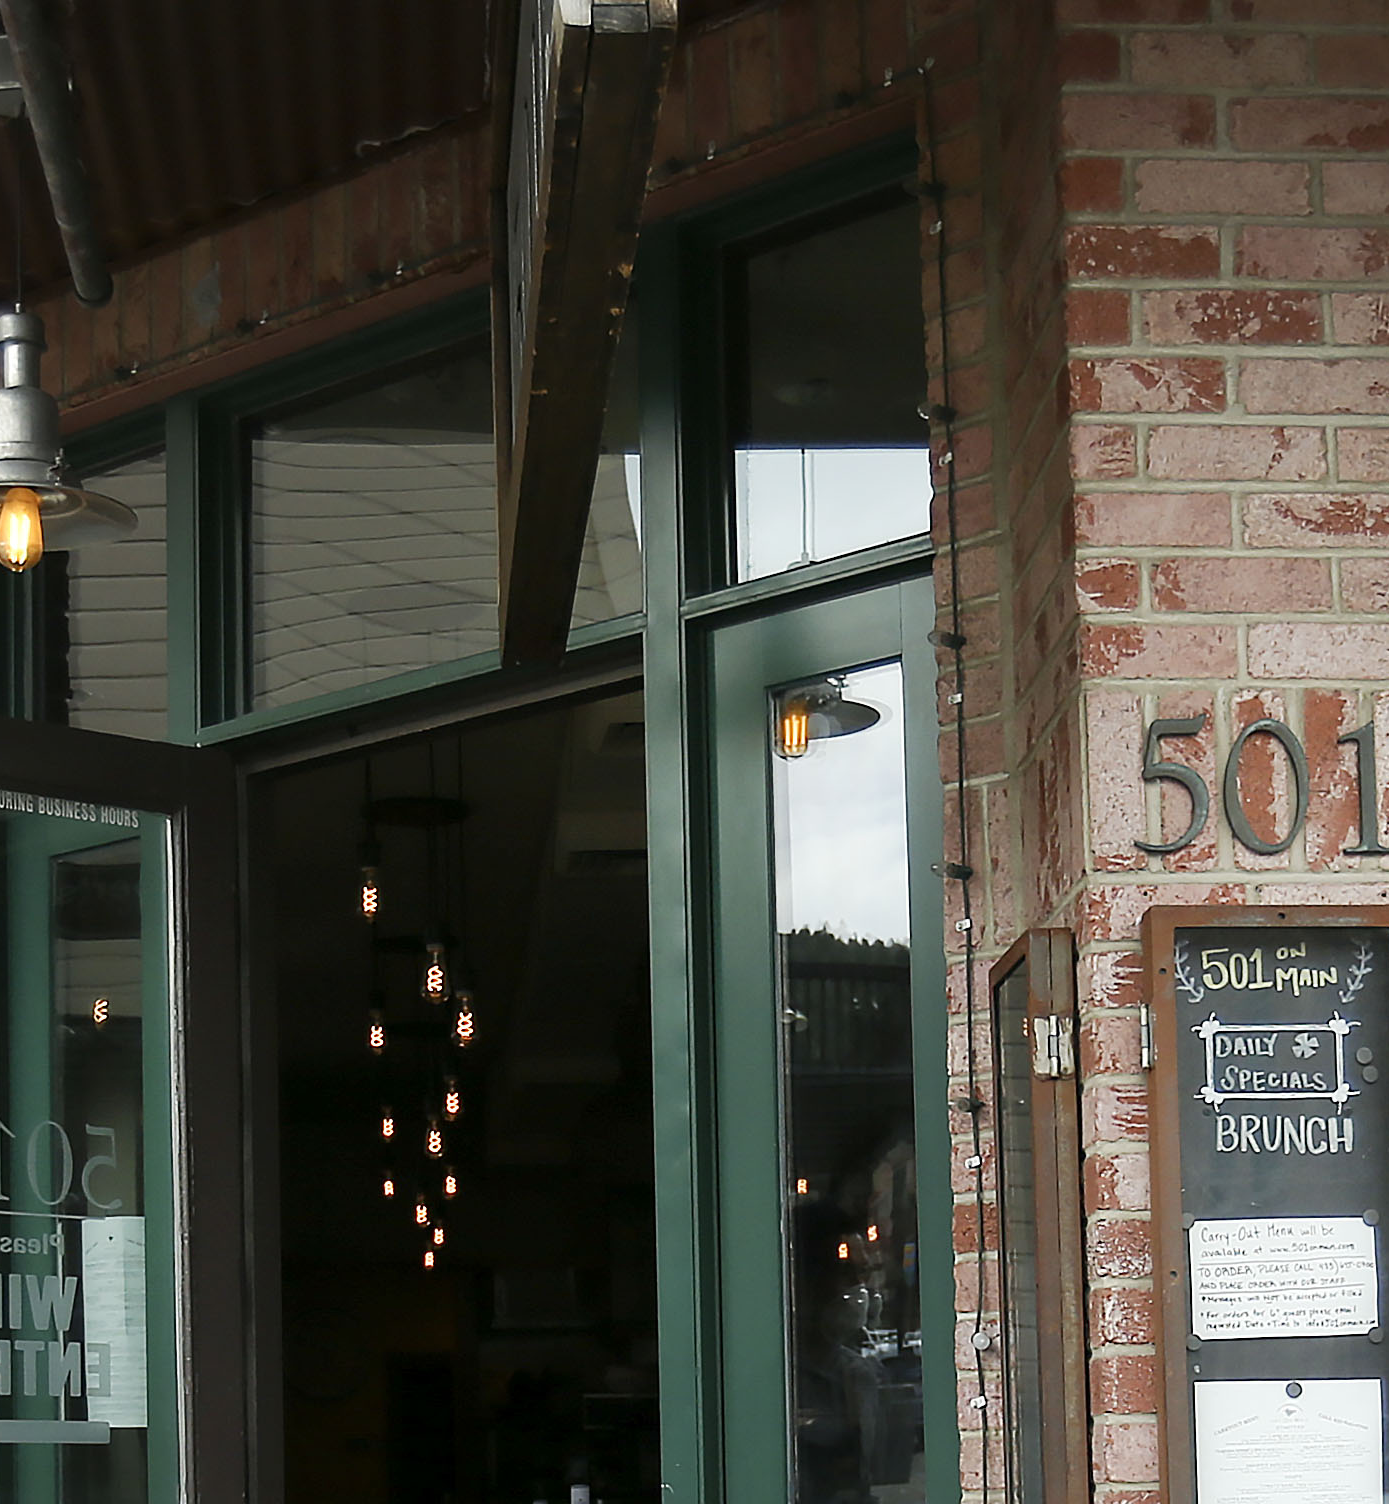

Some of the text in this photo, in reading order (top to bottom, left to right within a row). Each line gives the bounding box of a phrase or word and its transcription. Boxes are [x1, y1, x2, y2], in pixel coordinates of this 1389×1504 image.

[38, 796, 96, 822] BUSINESS
[101, 805, 139, 828] HOURS
[1201, 942, 1339, 998] 501 ON MAIN
[1215, 1032, 1280, 1060] DAILY
[1220, 1065, 1328, 1093] SPECIALS
[1216, 1114, 1355, 1154] BRUNCH
[1201, 1226, 1260, 1246] Carry-Out
[1268, 1223, 1295, 1237] Menu
[1198, 1266, 1211, 1277] TO
